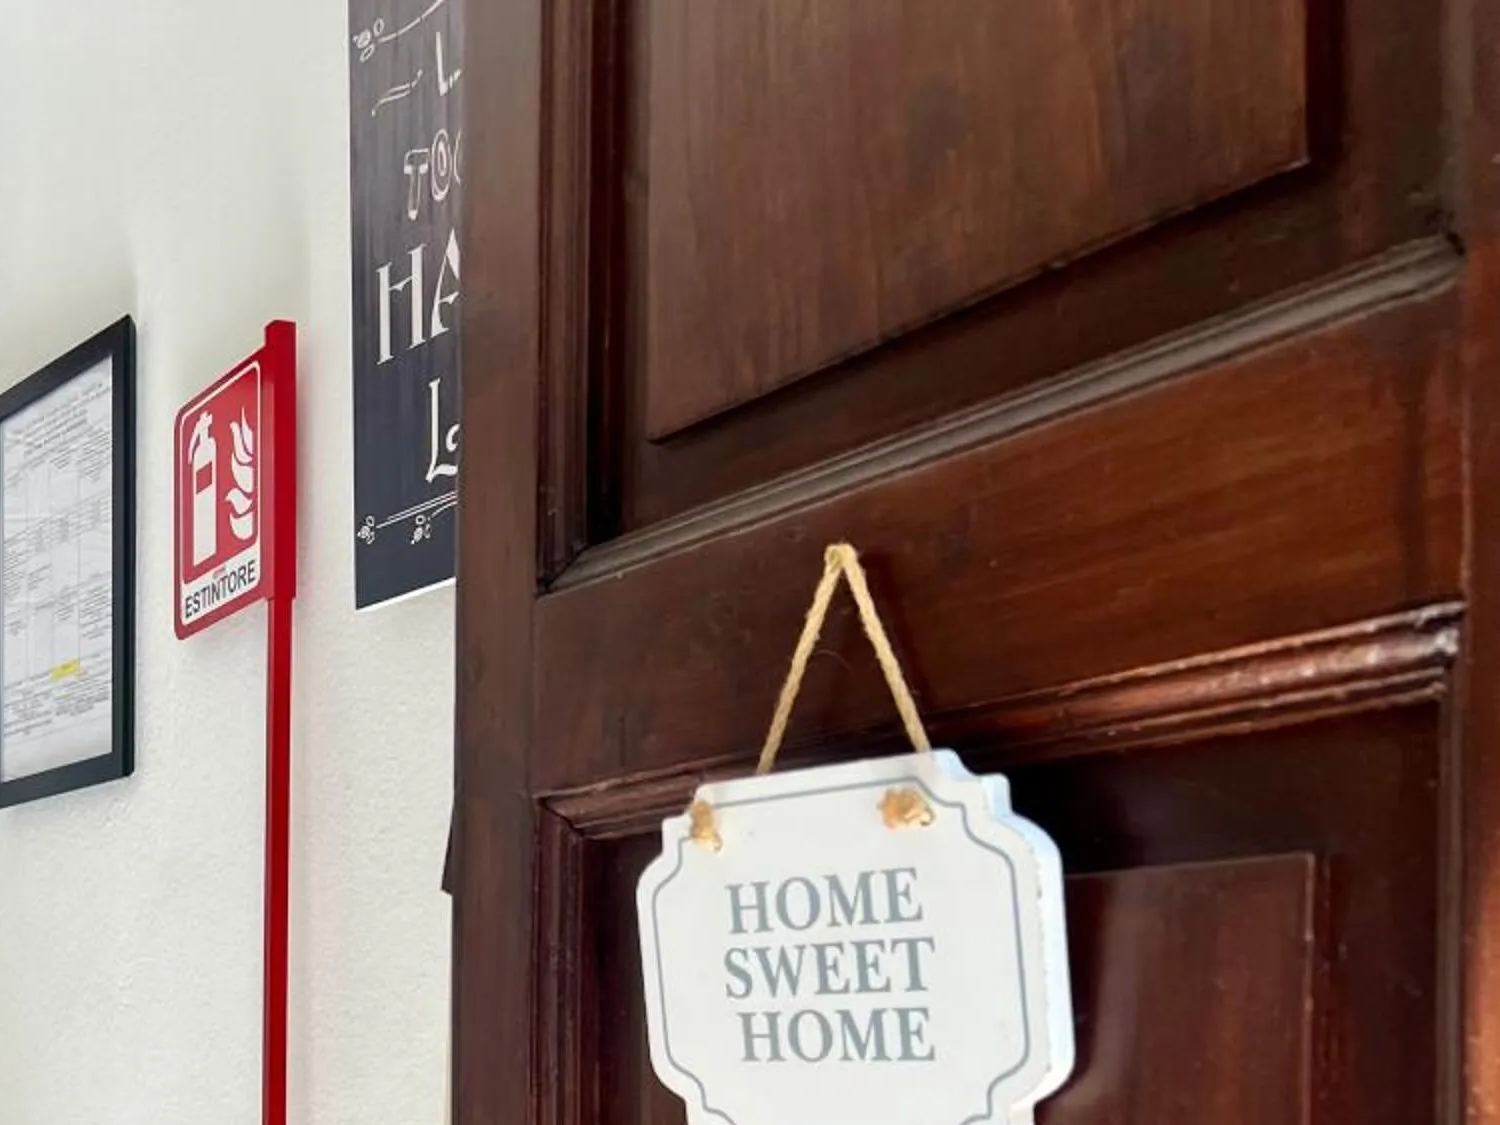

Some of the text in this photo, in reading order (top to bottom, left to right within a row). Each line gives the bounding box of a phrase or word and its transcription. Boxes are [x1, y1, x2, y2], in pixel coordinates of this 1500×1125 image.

[185, 560, 256, 618] ESTINTORE
[724, 867, 924, 934] HOME
[723, 937, 935, 1000] SWEET
[737, 1007, 936, 1063] HOME
